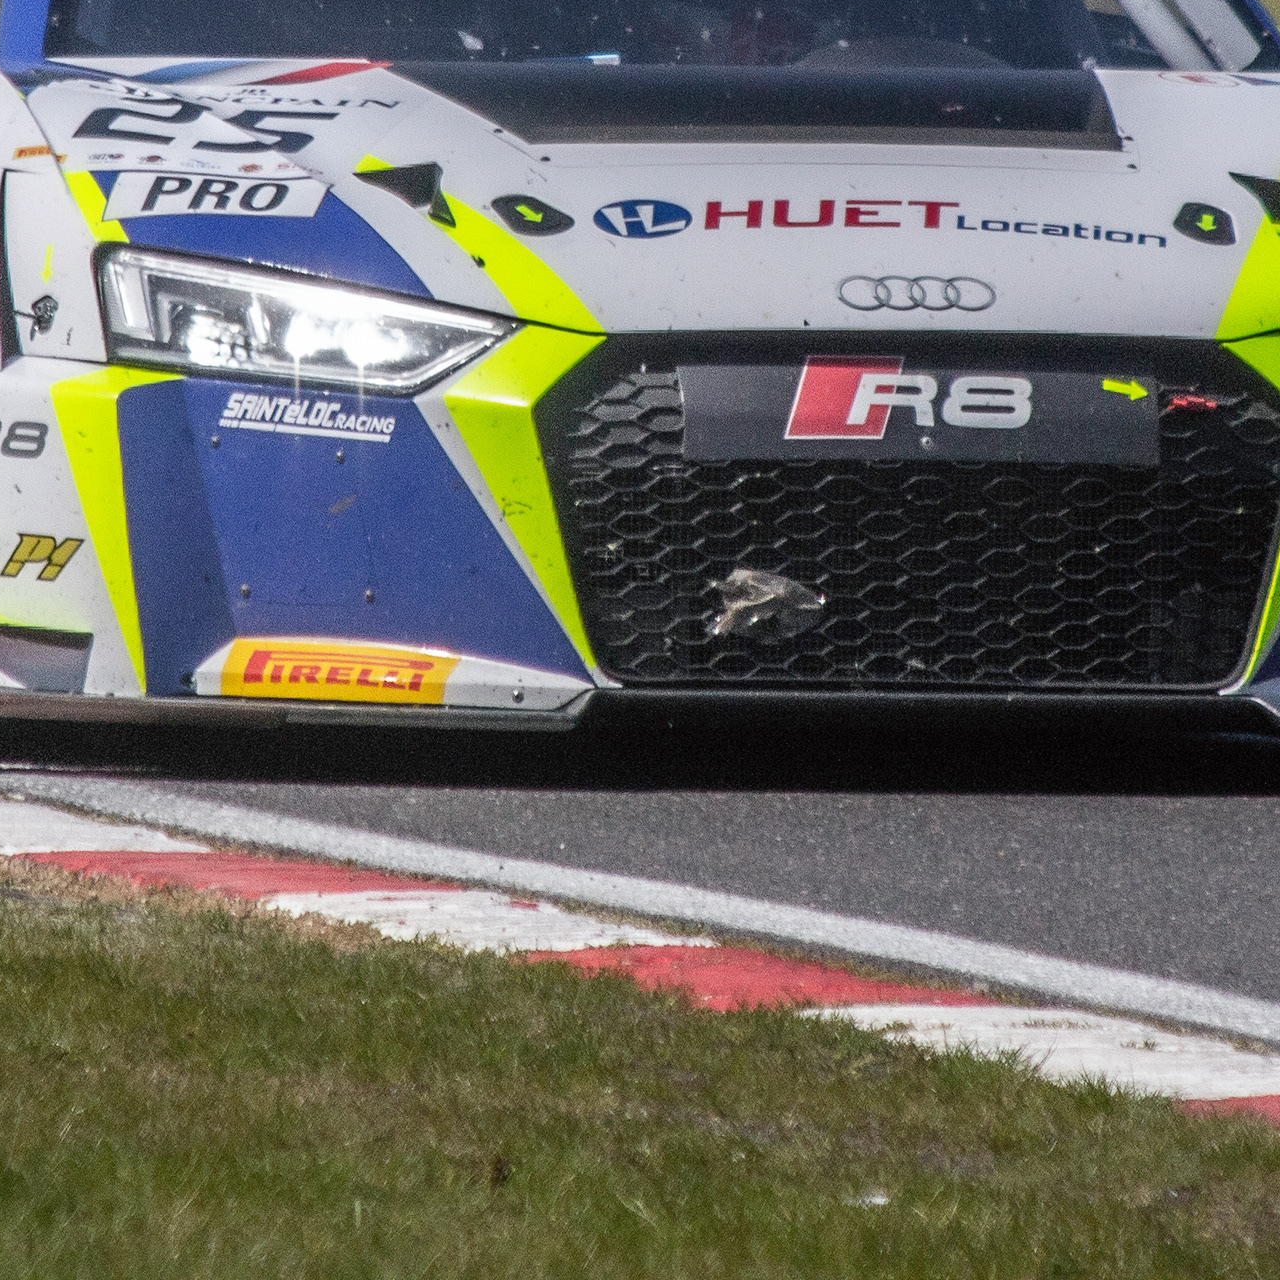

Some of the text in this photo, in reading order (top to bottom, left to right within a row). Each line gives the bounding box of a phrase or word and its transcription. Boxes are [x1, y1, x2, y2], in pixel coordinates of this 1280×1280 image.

[72, 96, 340, 154] 25
[141, 176, 289, 213] PRO
[704, 200, 960, 231] HUET
[956, 215, 1168, 248] Location
[845, 373, 1032, 429] R8
[243, 649, 435, 693] PIRELLI
